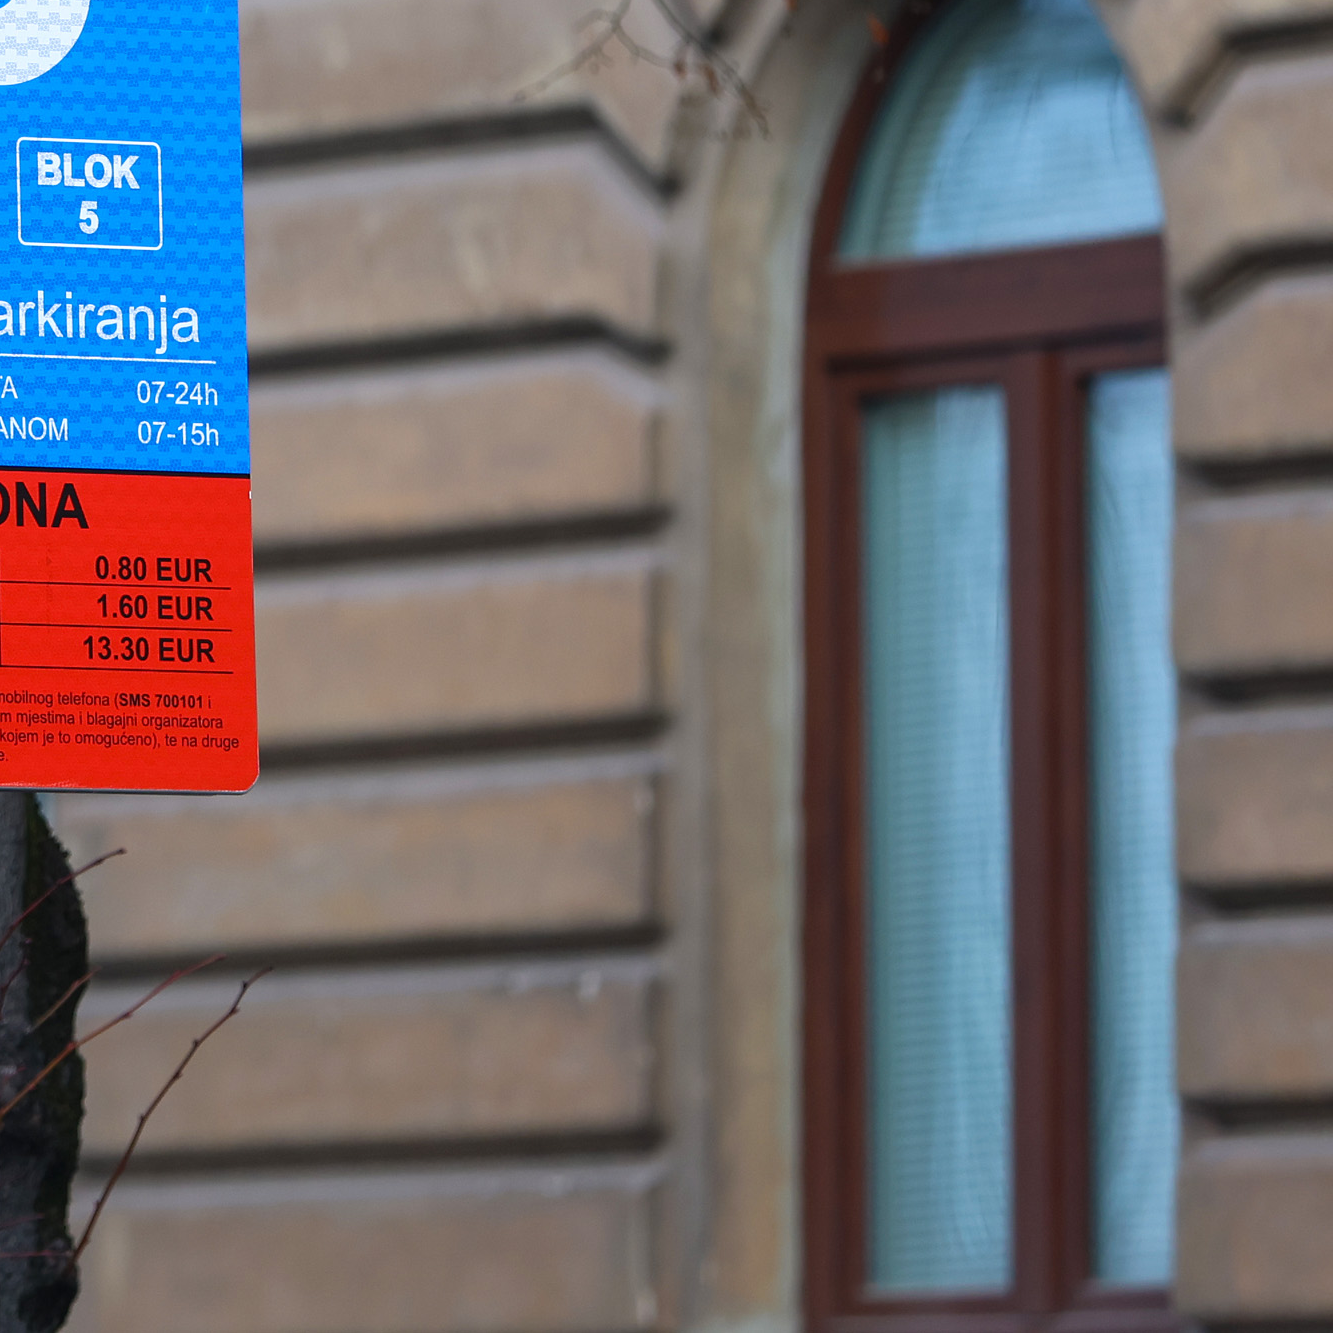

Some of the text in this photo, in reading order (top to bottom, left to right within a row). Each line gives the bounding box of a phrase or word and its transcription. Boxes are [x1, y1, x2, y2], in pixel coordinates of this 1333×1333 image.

[38, 152, 140, 189] BLOK
[79, 201, 99, 234] 5
[137, 381, 217, 405] 07-24h
[138, 421, 218, 445] 07-15h
[96, 556, 146, 580] 0.80
[157, 558, 212, 582] EUR
[98, 594, 147, 618] 1.60
[158, 596, 213, 620] EUR
[84, 636, 149, 661] 13.30
[159, 638, 214, 662] EUR
[58, 692, 109, 706] telefona
[115, 693, 150, 709] (SMS
[155, 694, 202, 708] 700101
[17, 712, 74, 726] mjestima
[87, 713, 137, 729] blagajni
[142, 716, 222, 730] organizatora
[0, 729, 38, 745] kojem
[43, 733, 54, 746] je
[59, 732, 70, 743] to
[75, 733, 160, 748] omogućeno),
[165, 734, 177, 746] te
[182, 737, 197, 747] na
[202, 735, 239, 751] druge
